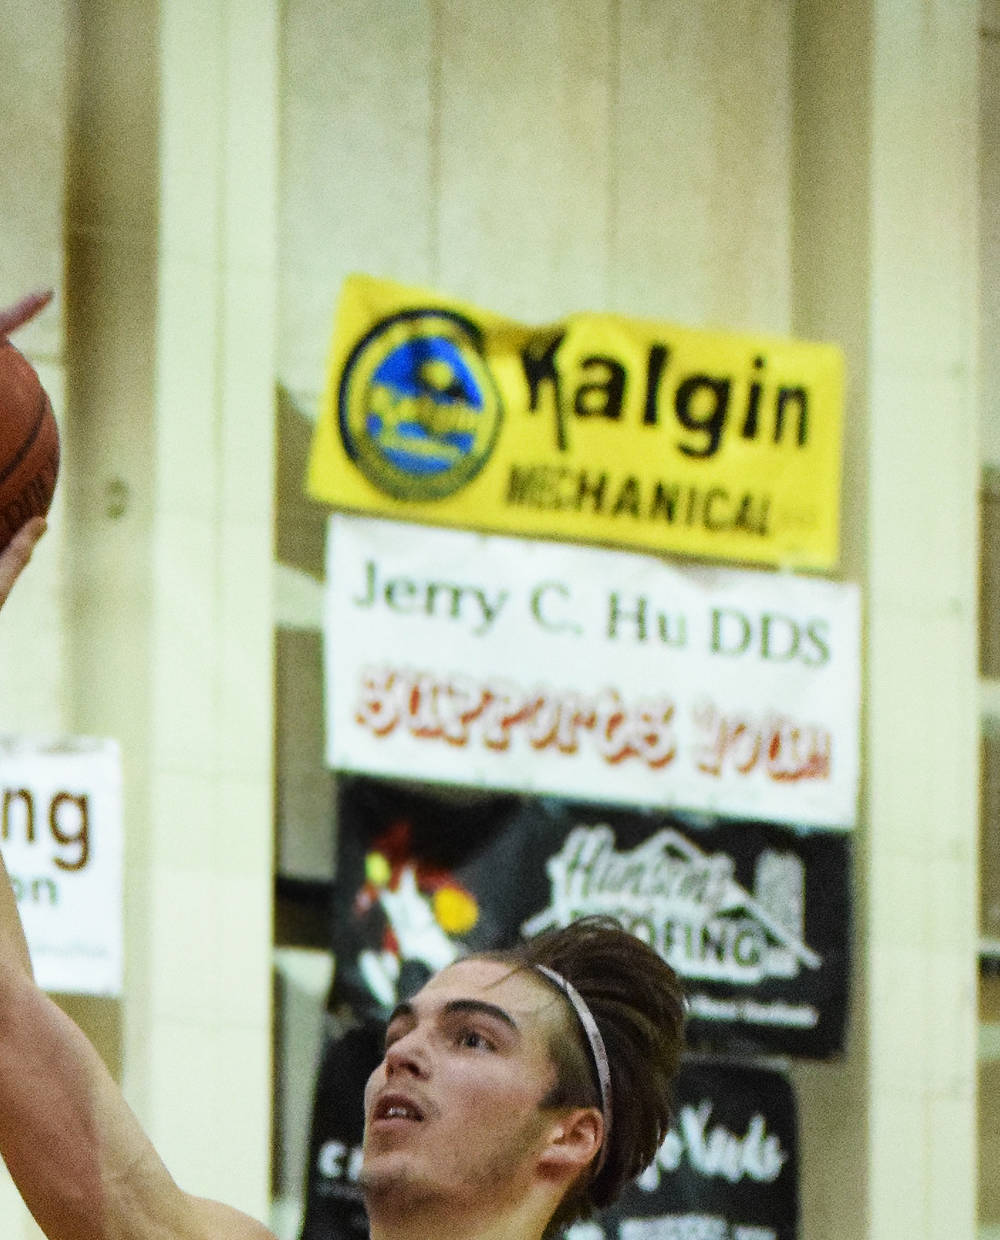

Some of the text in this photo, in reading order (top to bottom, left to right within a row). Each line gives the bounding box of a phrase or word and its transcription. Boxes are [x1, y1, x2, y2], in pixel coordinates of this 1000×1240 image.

[518, 328, 810, 462] Kalgin
[506, 464, 771, 537] MECHANICAL
[353, 559, 832, 668] Jerry C. Hu DDS
